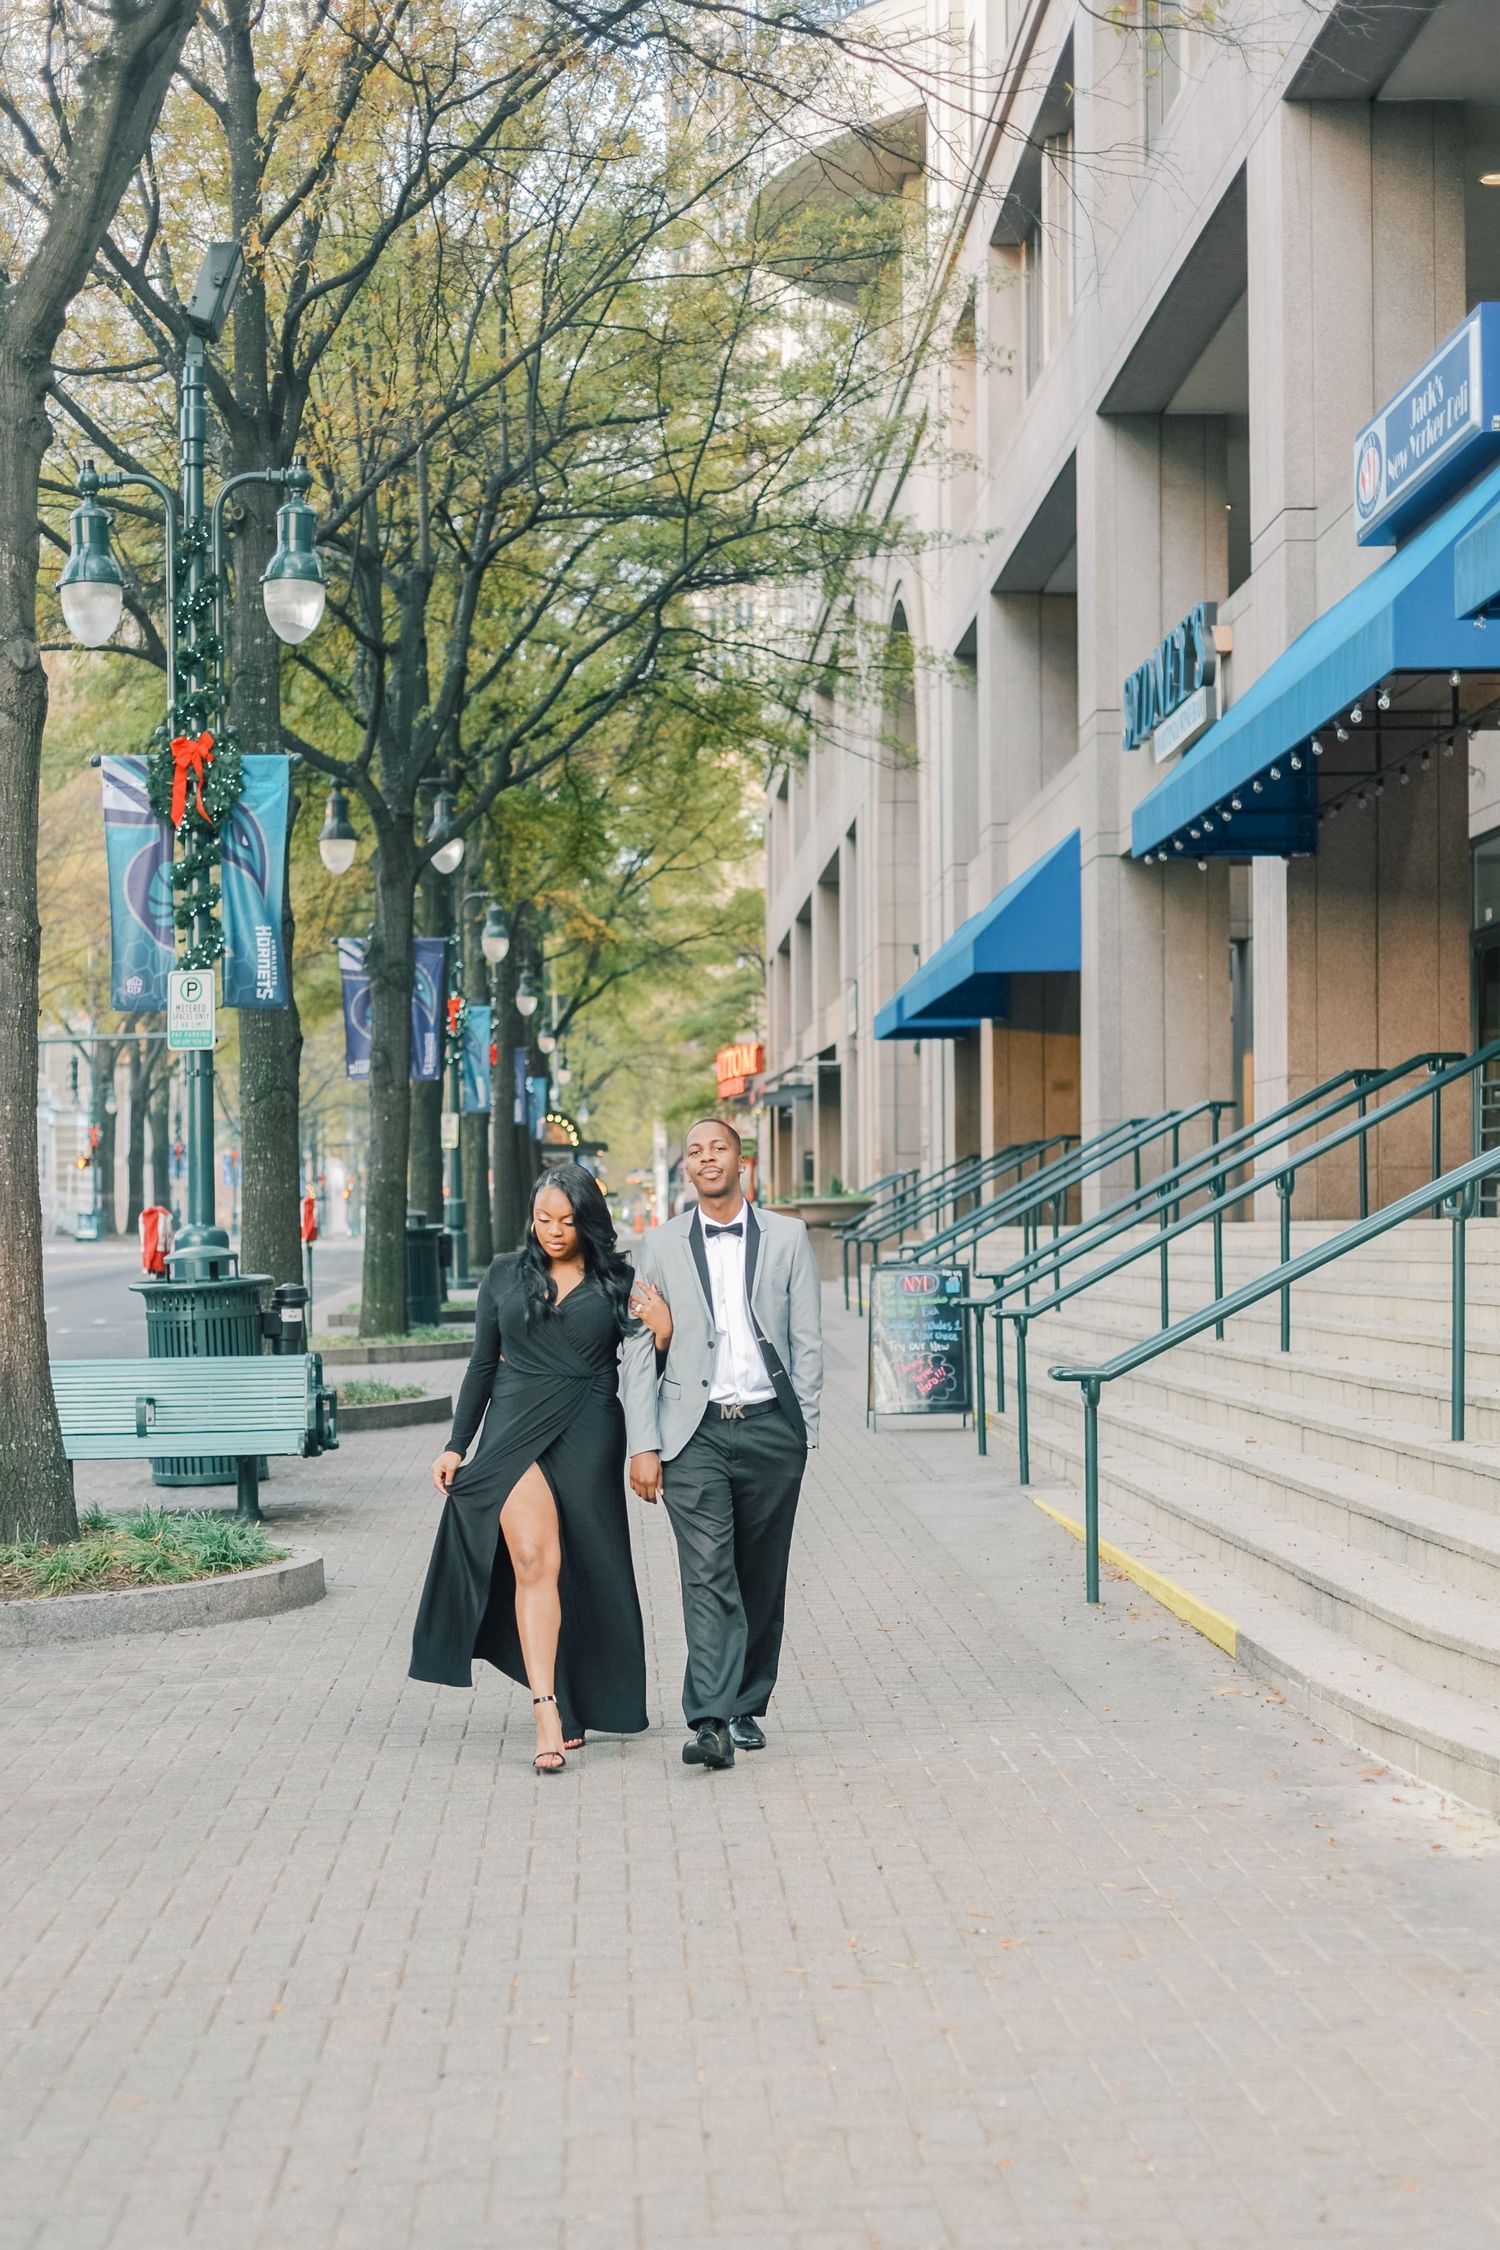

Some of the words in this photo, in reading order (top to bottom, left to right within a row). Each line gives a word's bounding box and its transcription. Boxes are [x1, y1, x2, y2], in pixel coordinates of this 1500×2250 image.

[1410, 375, 1444, 429] Jack's
[1387, 448, 1408, 484] New
[1409, 408, 1446, 459] Yorker
[1447, 380, 1468, 426] Deli
[255, 925, 273, 1000] HORNETS
[187, 982, 198, 997] P
[176, 1003, 207, 1013] METERED
[191, 1021, 208, 1029] LIMIT
[720, 1404, 745, 1419] MK
